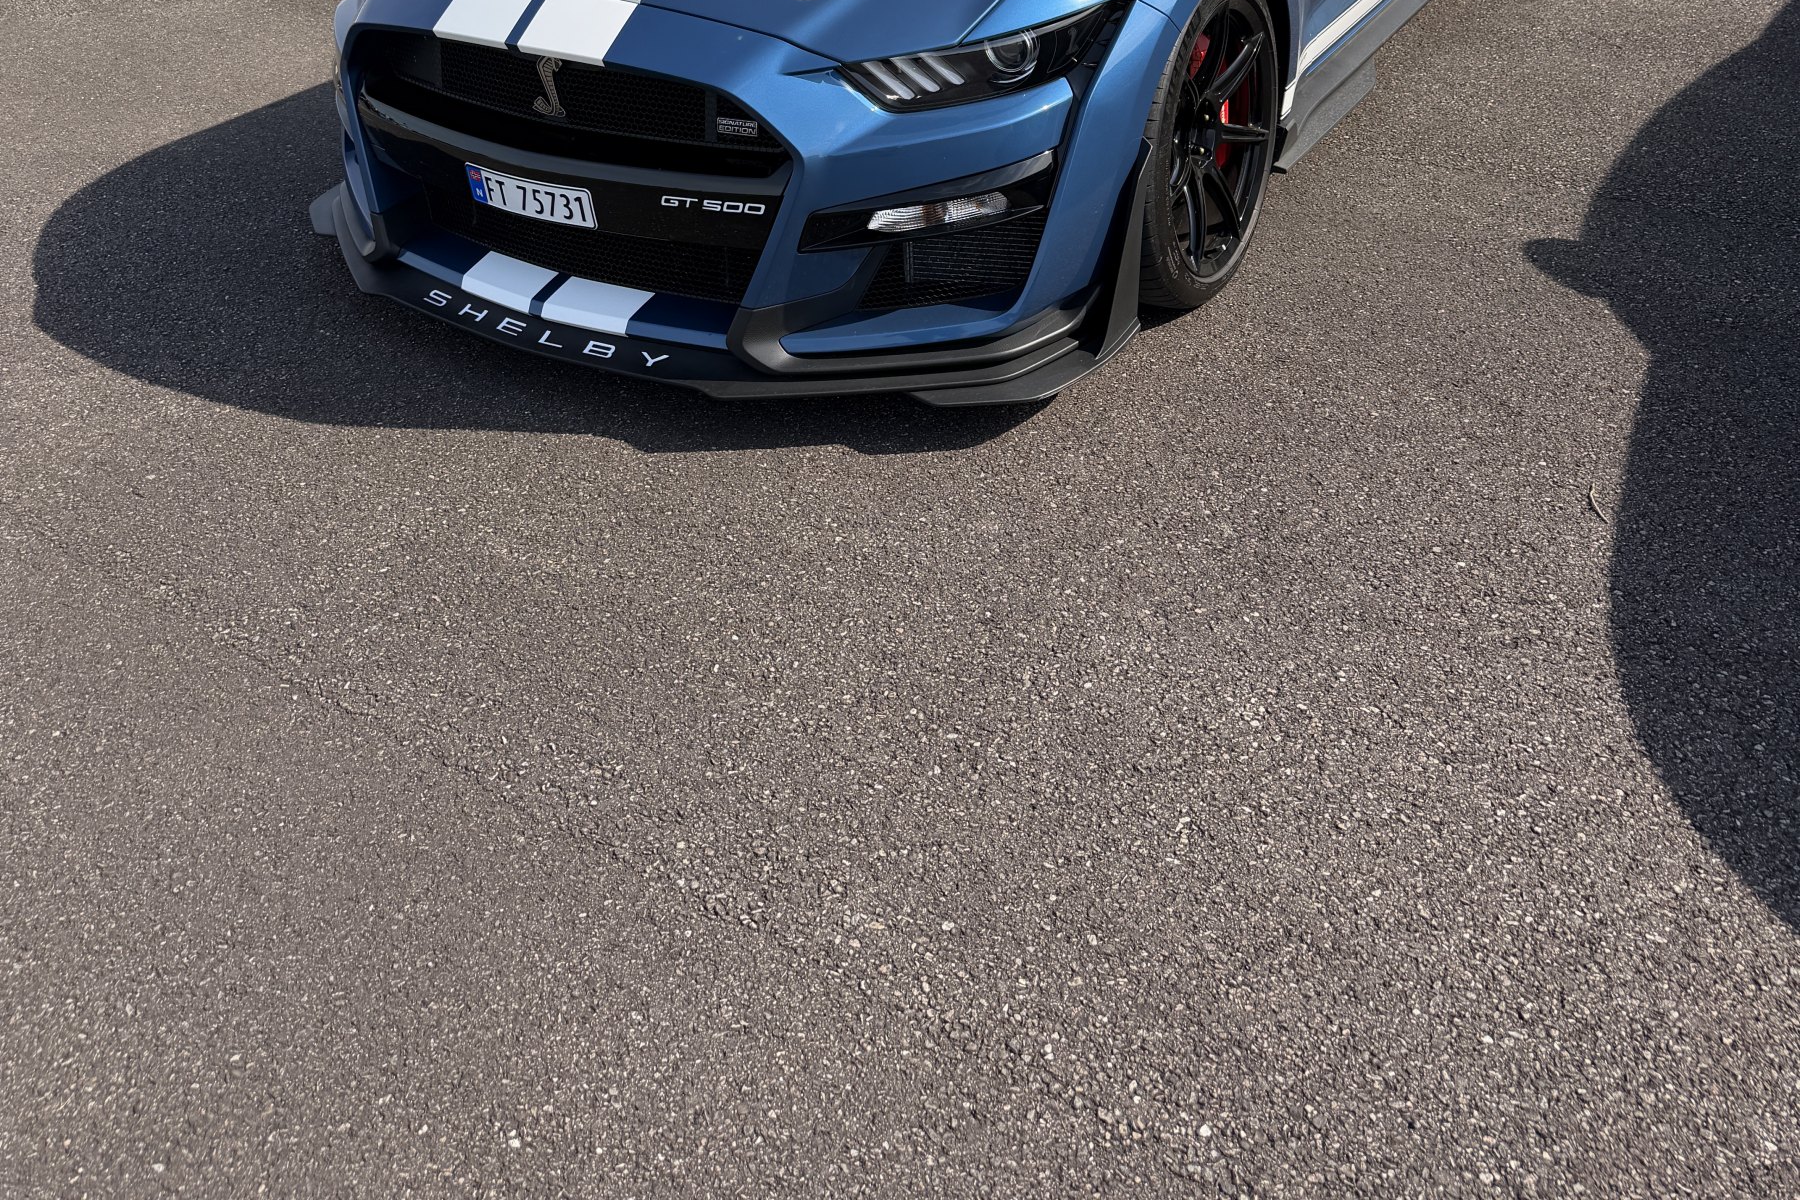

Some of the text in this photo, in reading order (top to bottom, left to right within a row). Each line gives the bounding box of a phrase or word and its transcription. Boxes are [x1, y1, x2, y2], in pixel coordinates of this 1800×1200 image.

[718, 119, 756, 129] SIGNATURE
[718, 125, 756, 135] EDITION
[475, 187, 484, 198] N
[484, 176, 587, 222] FT 75731
[661, 195, 766, 215] GT 500
[423, 289, 670, 367] SHELBY
